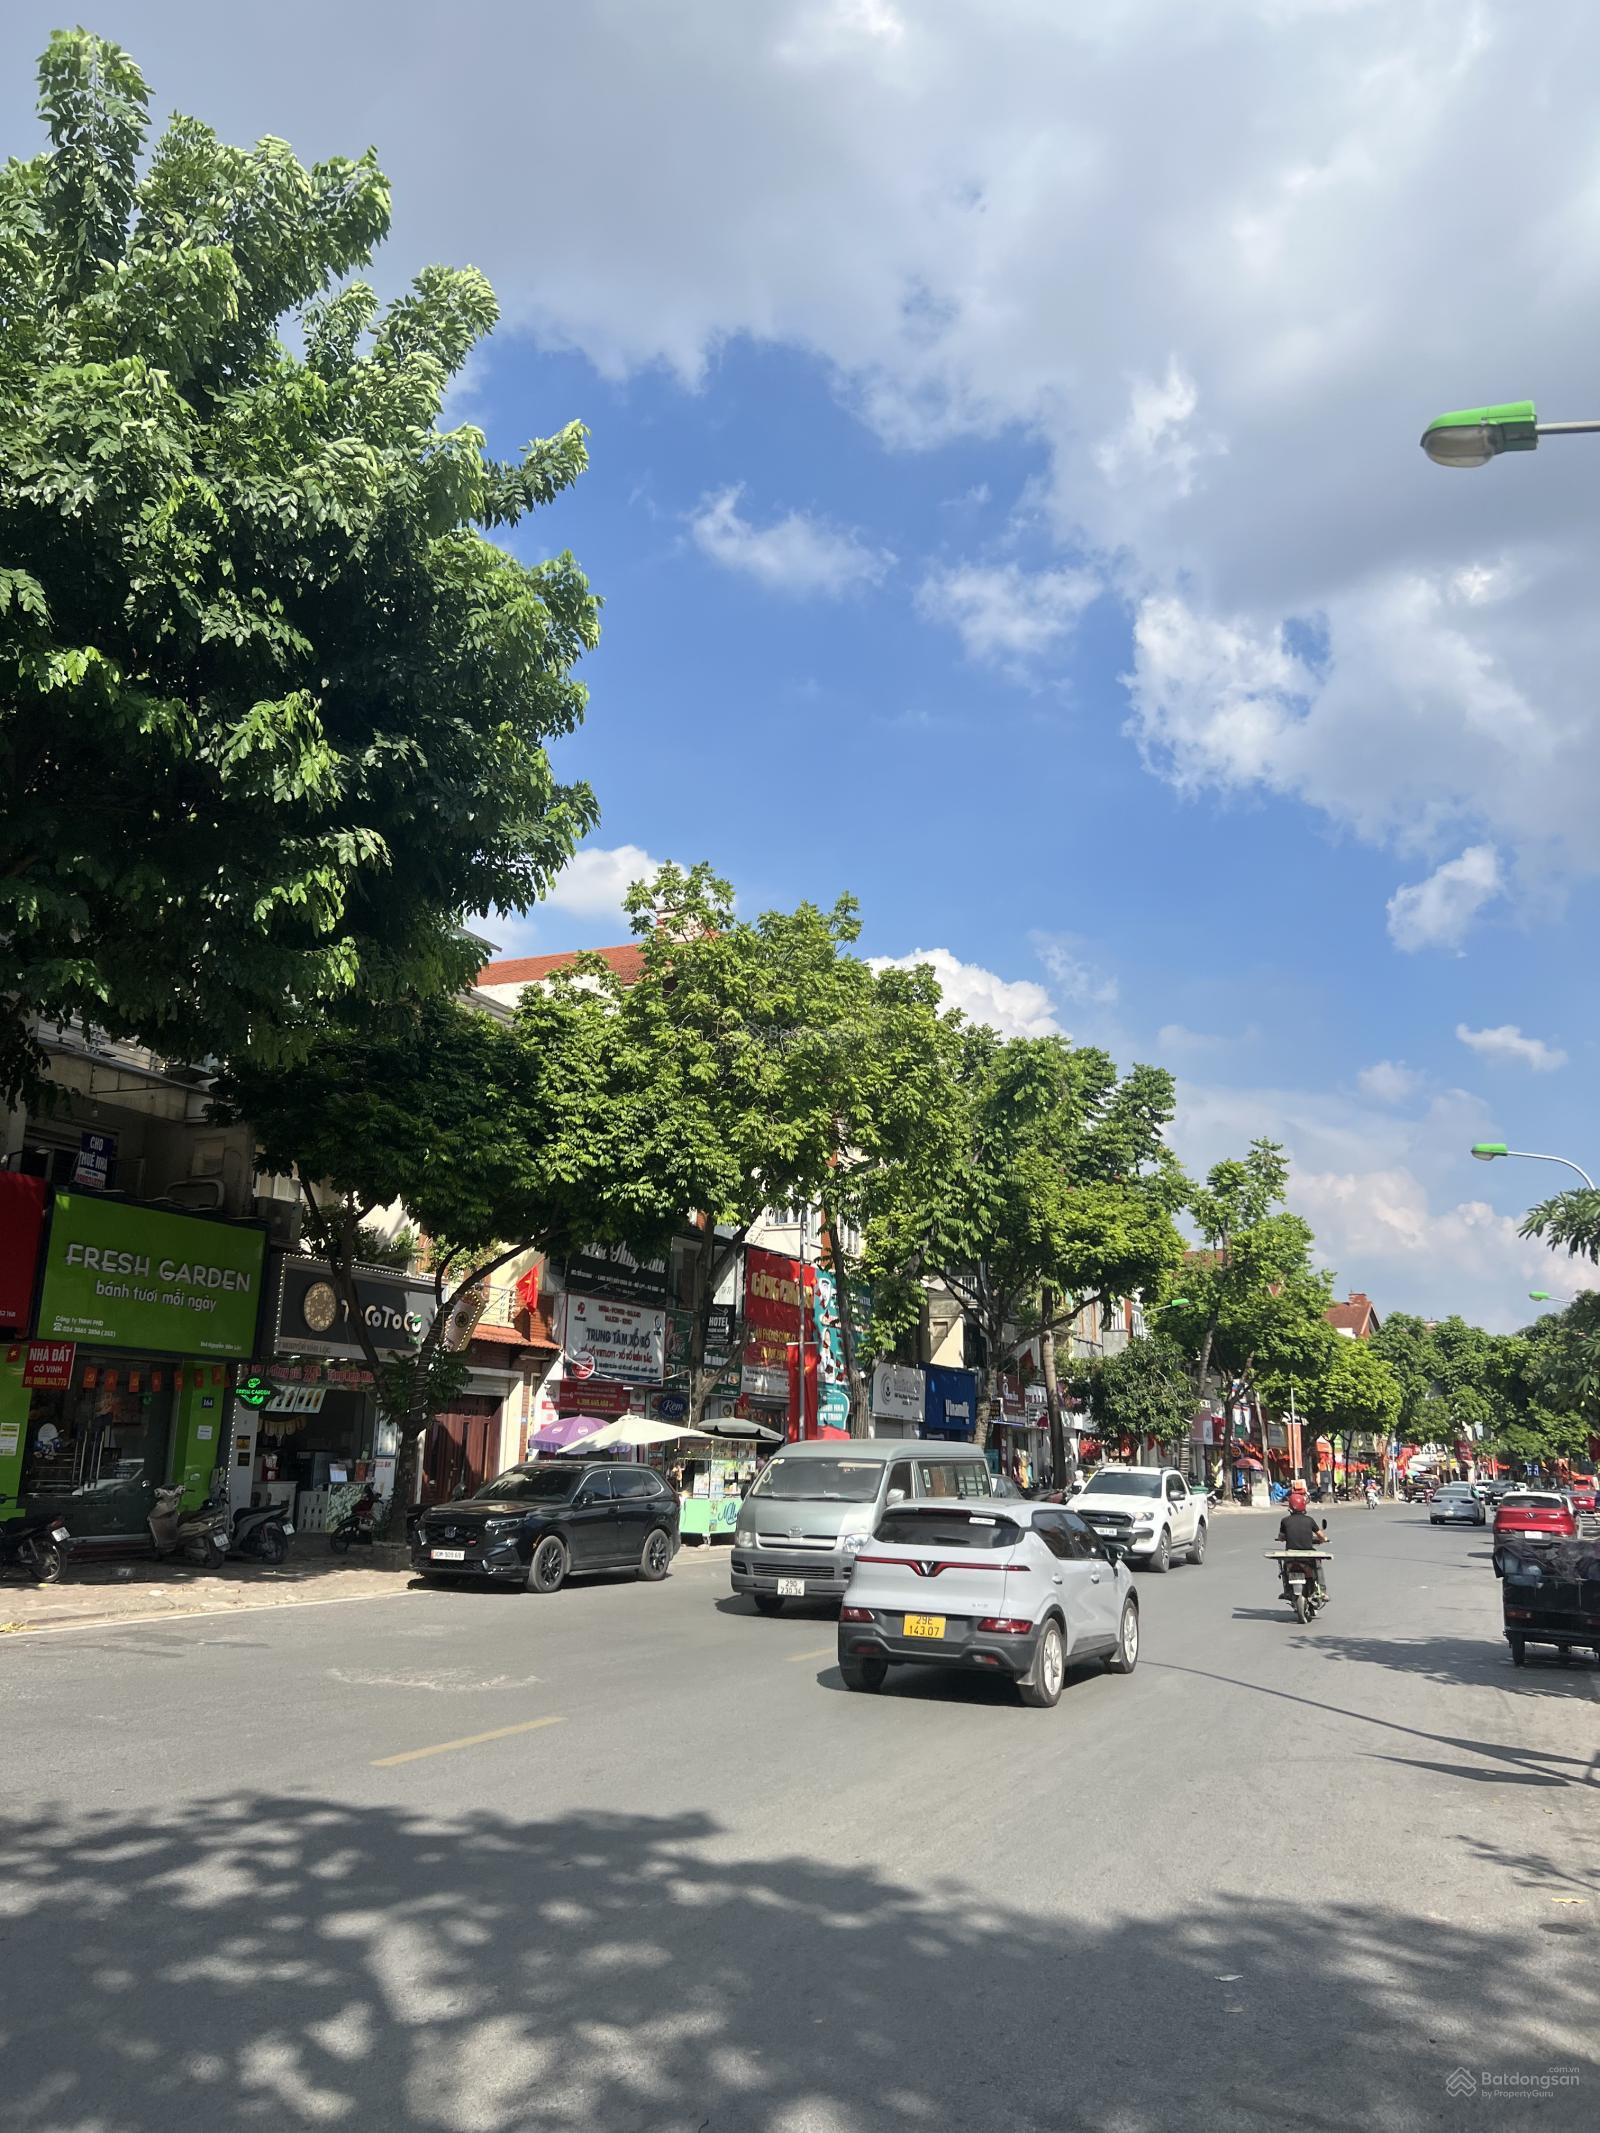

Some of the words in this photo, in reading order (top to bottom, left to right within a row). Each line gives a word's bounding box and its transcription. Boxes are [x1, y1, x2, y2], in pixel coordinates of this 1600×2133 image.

[90, 1136, 104, 1151] CHO
[66, 1243, 150, 1277] FRESH
[159, 1260, 250, 1292] GARDEN
[96, 1280, 130, 1298] bánh
[133, 1287, 159, 1304] tươi
[162, 1288, 185, 1306] mỗi
[187, 1295, 217, 1313] ngày
[708, 1316, 729, 1328] HOTEL
[586, 1327, 611, 1343] TRUNG
[29, 1345, 50, 1362] NHÀ
[52, 1344, 71, 1362] ĐẤT
[46, 1365, 63, 1374] VINH
[916, 1615, 933, 1625] 29E
